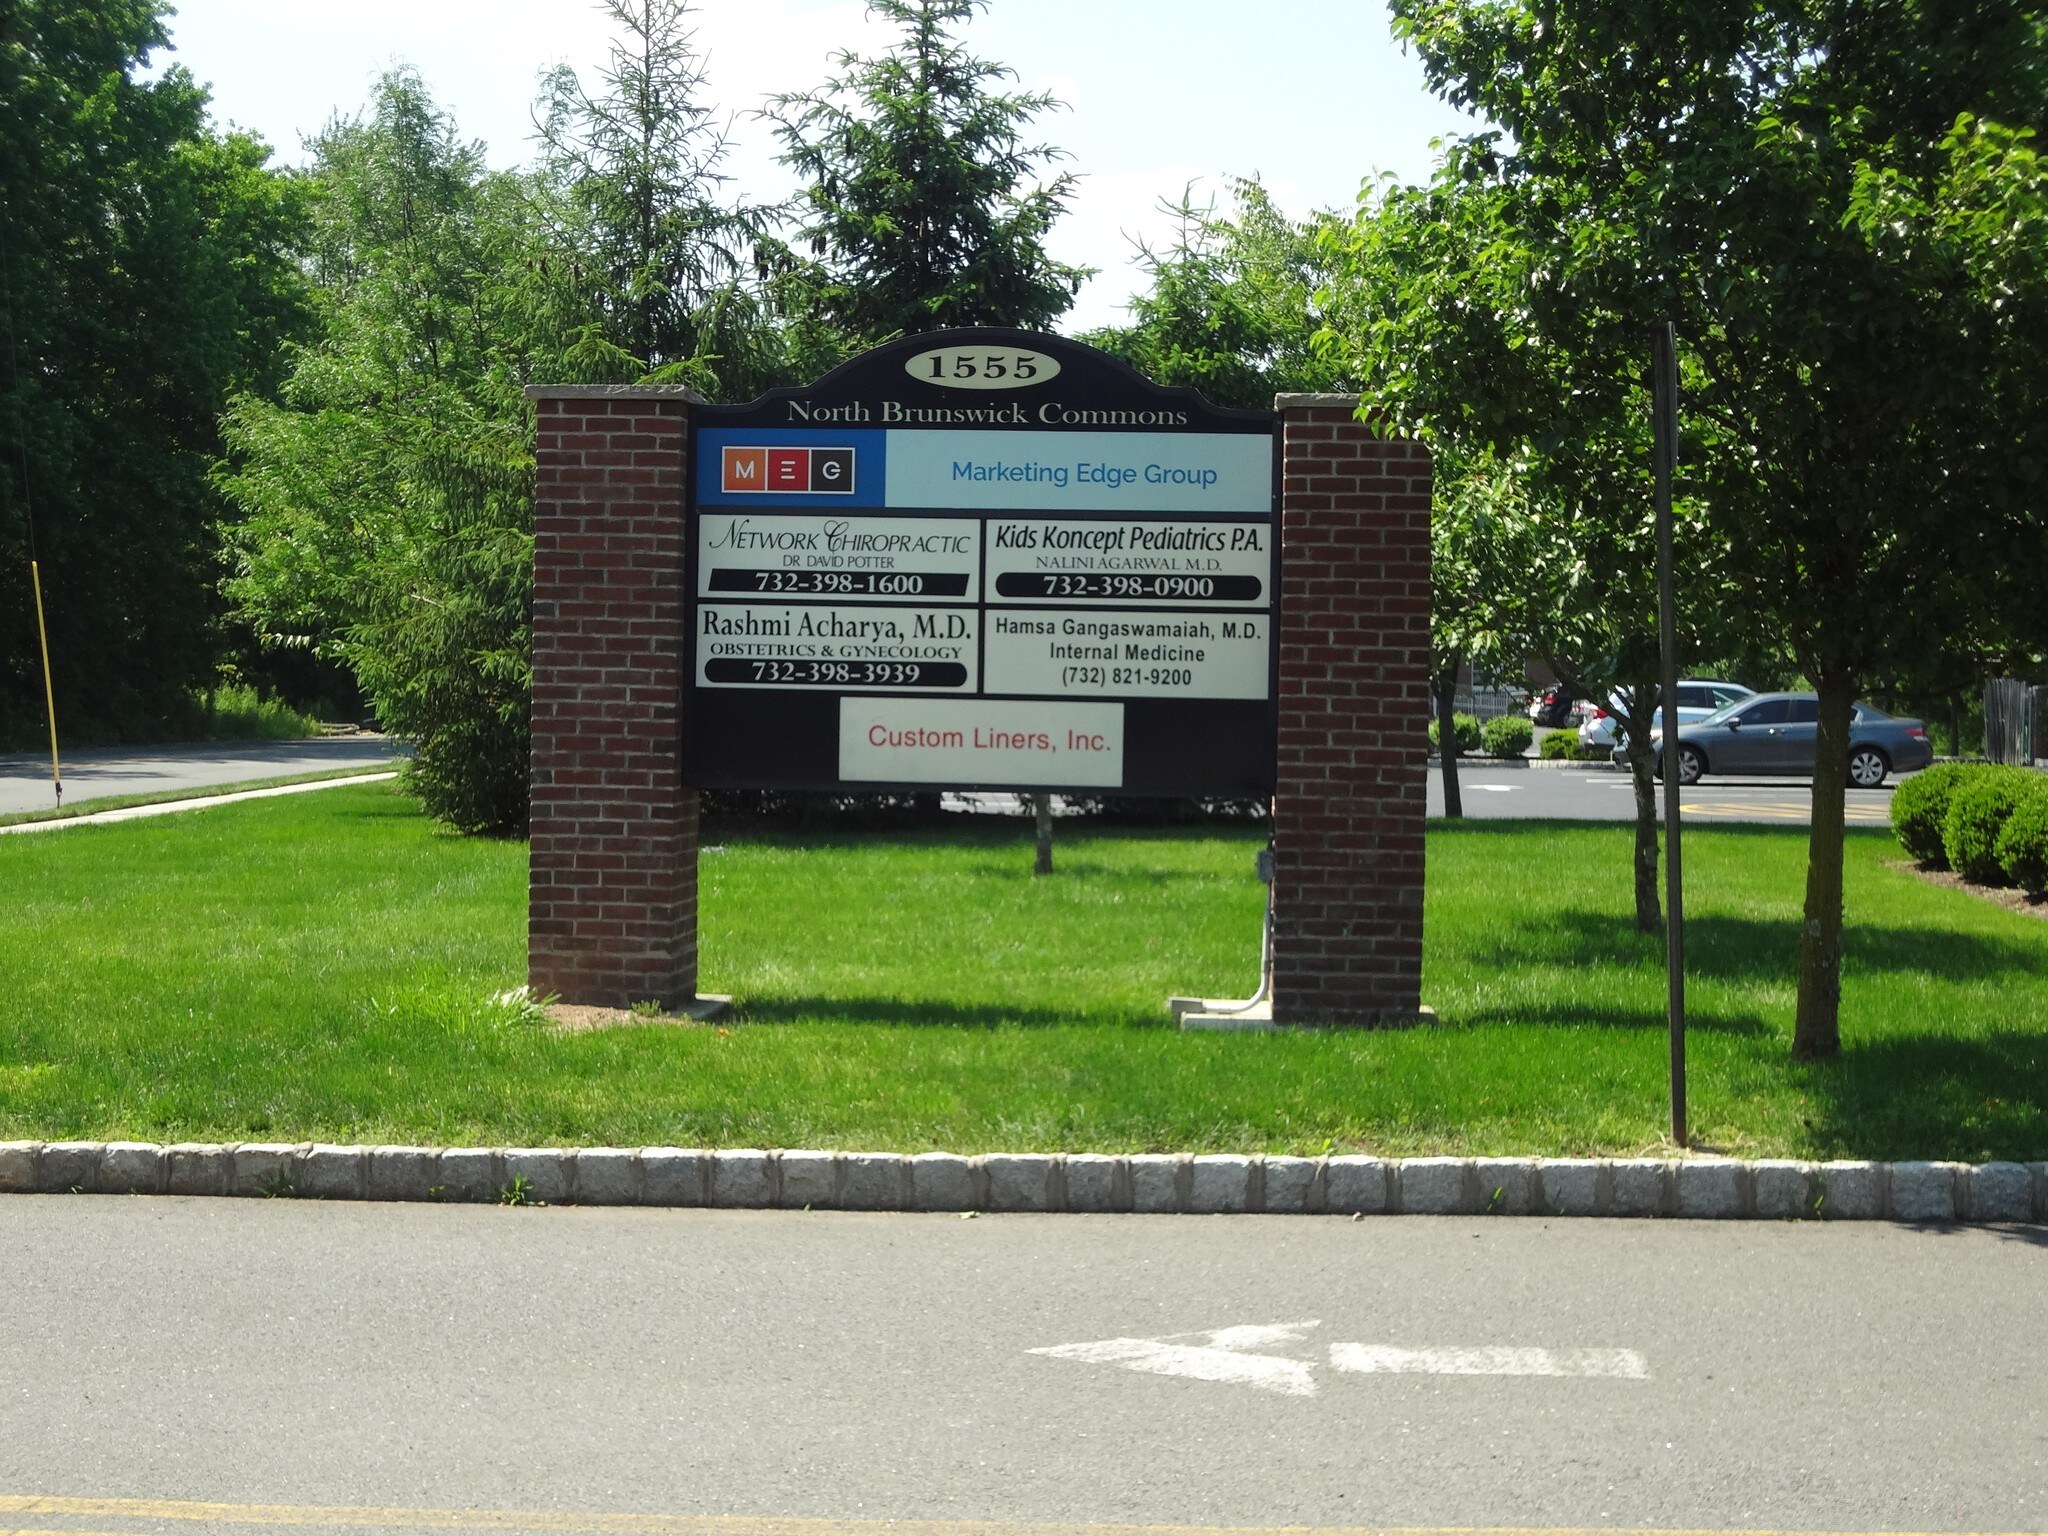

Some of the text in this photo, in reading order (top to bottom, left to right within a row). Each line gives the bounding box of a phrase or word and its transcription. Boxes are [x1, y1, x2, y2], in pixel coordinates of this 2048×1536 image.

[928, 355, 1037, 379] 1555
[787, 400, 1188, 426] North Brunswick Commons
[952, 461, 1218, 490] Marketing Edge Group
[995, 525, 1263, 554] Kids Koncept Pediatrics P.A.
[783, 555, 895, 569] DR DAVID POTTER
[1036, 556, 1222, 572] NALINI AGARWAL M.D.
[755, 572, 923, 594] 732-398-1600
[1043, 575, 1214, 597] 732-398-0900
[703, 610, 971, 644] Rashmi Acharya, M.D.
[996, 617, 1261, 640] Hamsa Gangaswamaiah, M.D.
[710, 642, 962, 659] OBSTETRICS & GYNECOLOGY
[1050, 642, 1205, 662] Internal Medicine
[751, 661, 920, 683] 732-398-3939
[1062, 666, 1192, 687] (732) 821-9200
[868, 725, 1111, 753] Custom Liners, Inc.
